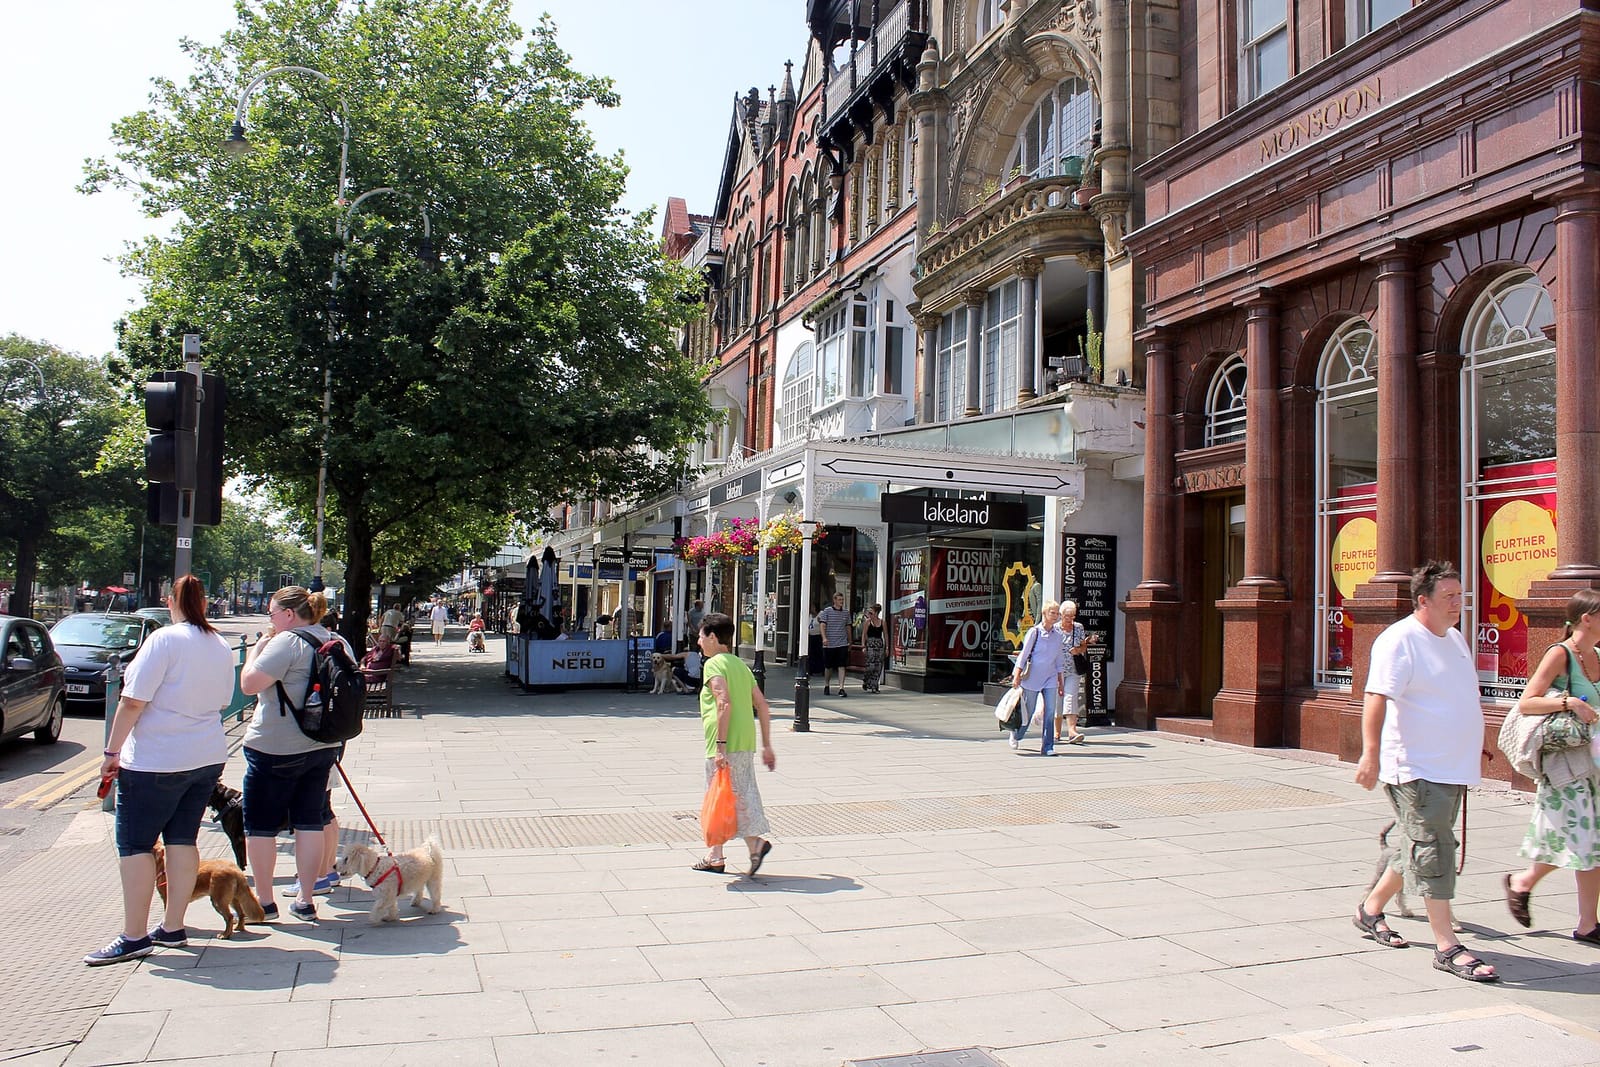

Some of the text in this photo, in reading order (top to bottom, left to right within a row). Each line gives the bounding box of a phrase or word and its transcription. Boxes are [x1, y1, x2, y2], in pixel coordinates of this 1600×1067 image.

[1260, 77, 1381, 163] MONSOON
[1184, 464, 1246, 492] MONSOO
[923, 500, 990, 525] lakeland
[179, 539, 190, 547] 16
[1495, 535, 1546, 550] FURTHER
[629, 557, 648, 565] Green
[947, 550, 1001, 567] CLOSING
[1065, 537, 1076, 584] BOOKS
[1486, 548, 1557, 564] REDUCTIONS
[1084, 562, 1106, 570] FOSSILS
[1334, 561, 1376, 572] REDUCTIO
[946, 564, 1000, 585] DOWN
[1328, 610, 1344, 625] 40
[945, 619, 999, 650] 70%
[1477, 627, 1500, 644] 40
[552, 658, 605, 670] NERO
[1092, 662, 1102, 703] BOOKS
[1484, 688, 1522, 699] MONSOO
